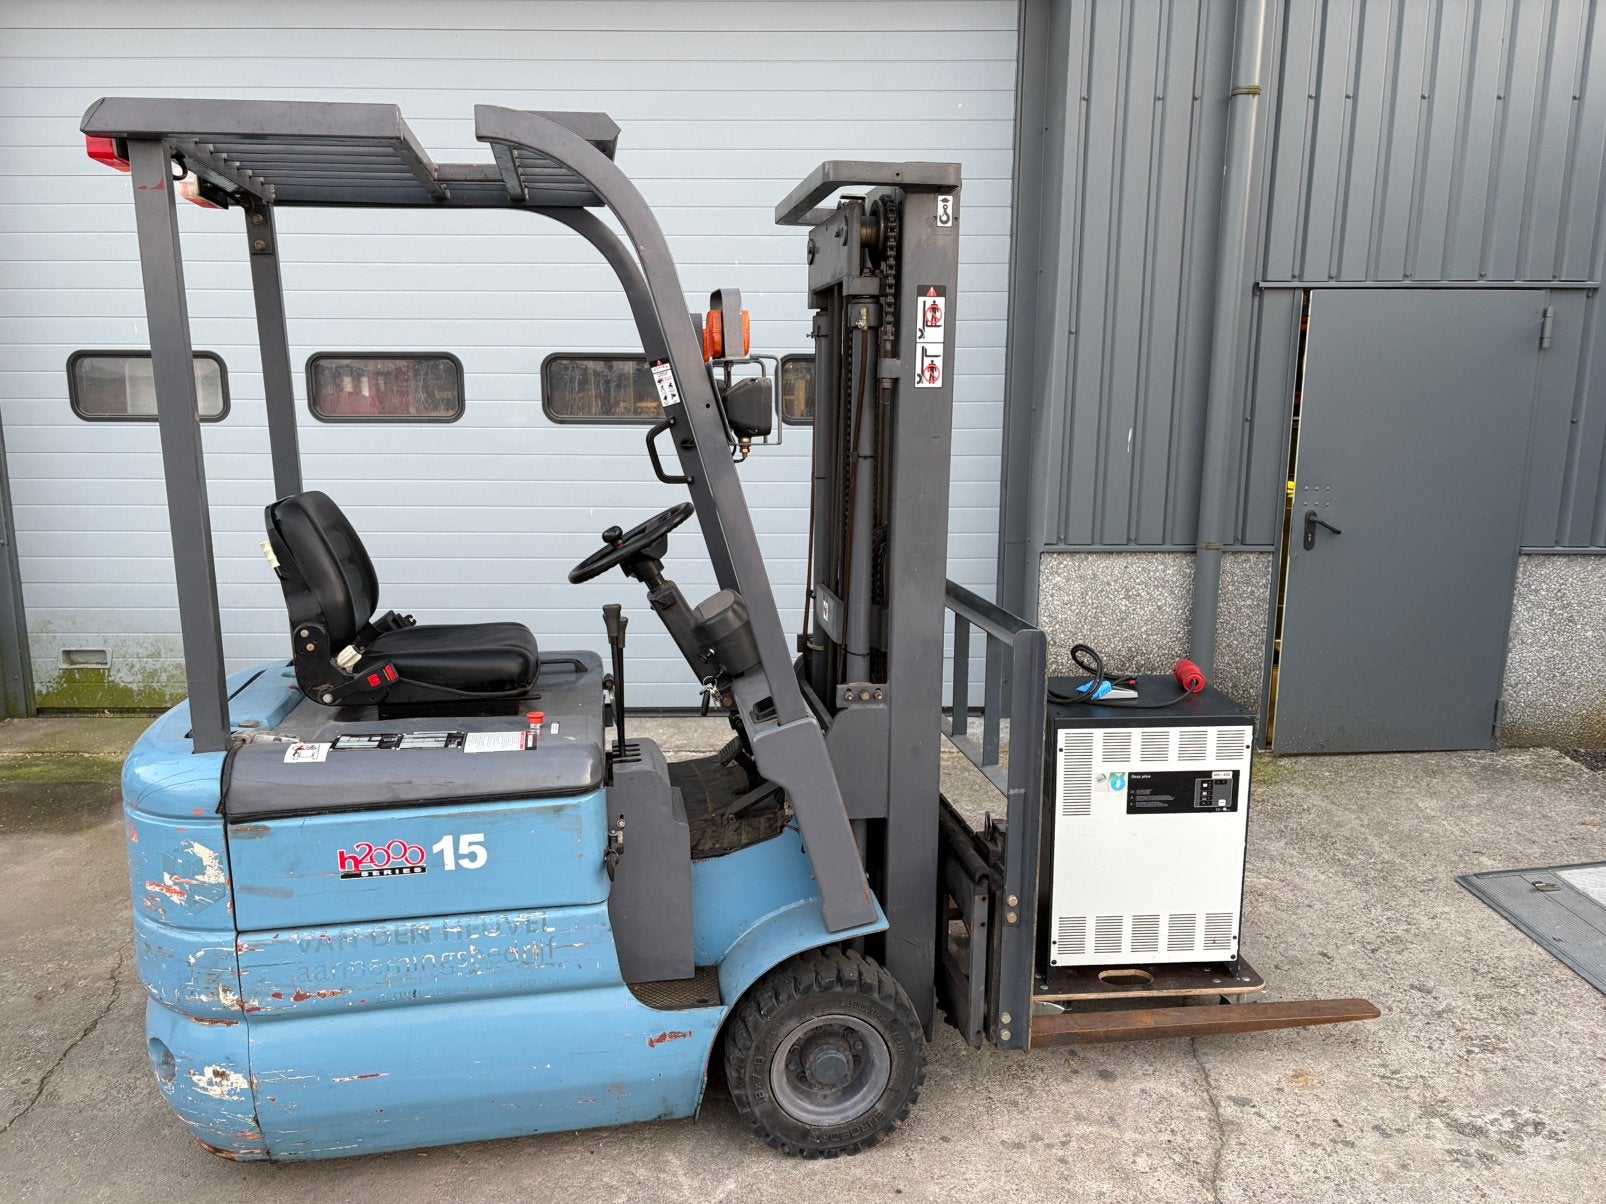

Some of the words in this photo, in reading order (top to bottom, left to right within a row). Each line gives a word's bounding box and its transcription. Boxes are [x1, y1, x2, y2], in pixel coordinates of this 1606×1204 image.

[337, 839, 426, 872] h2000
[432, 833, 488, 871] 15
[360, 866, 423, 878] SERIES
[297, 928, 359, 953] VAN
[370, 921, 431, 947] DEN
[442, 911, 555, 940] HEUVEL
